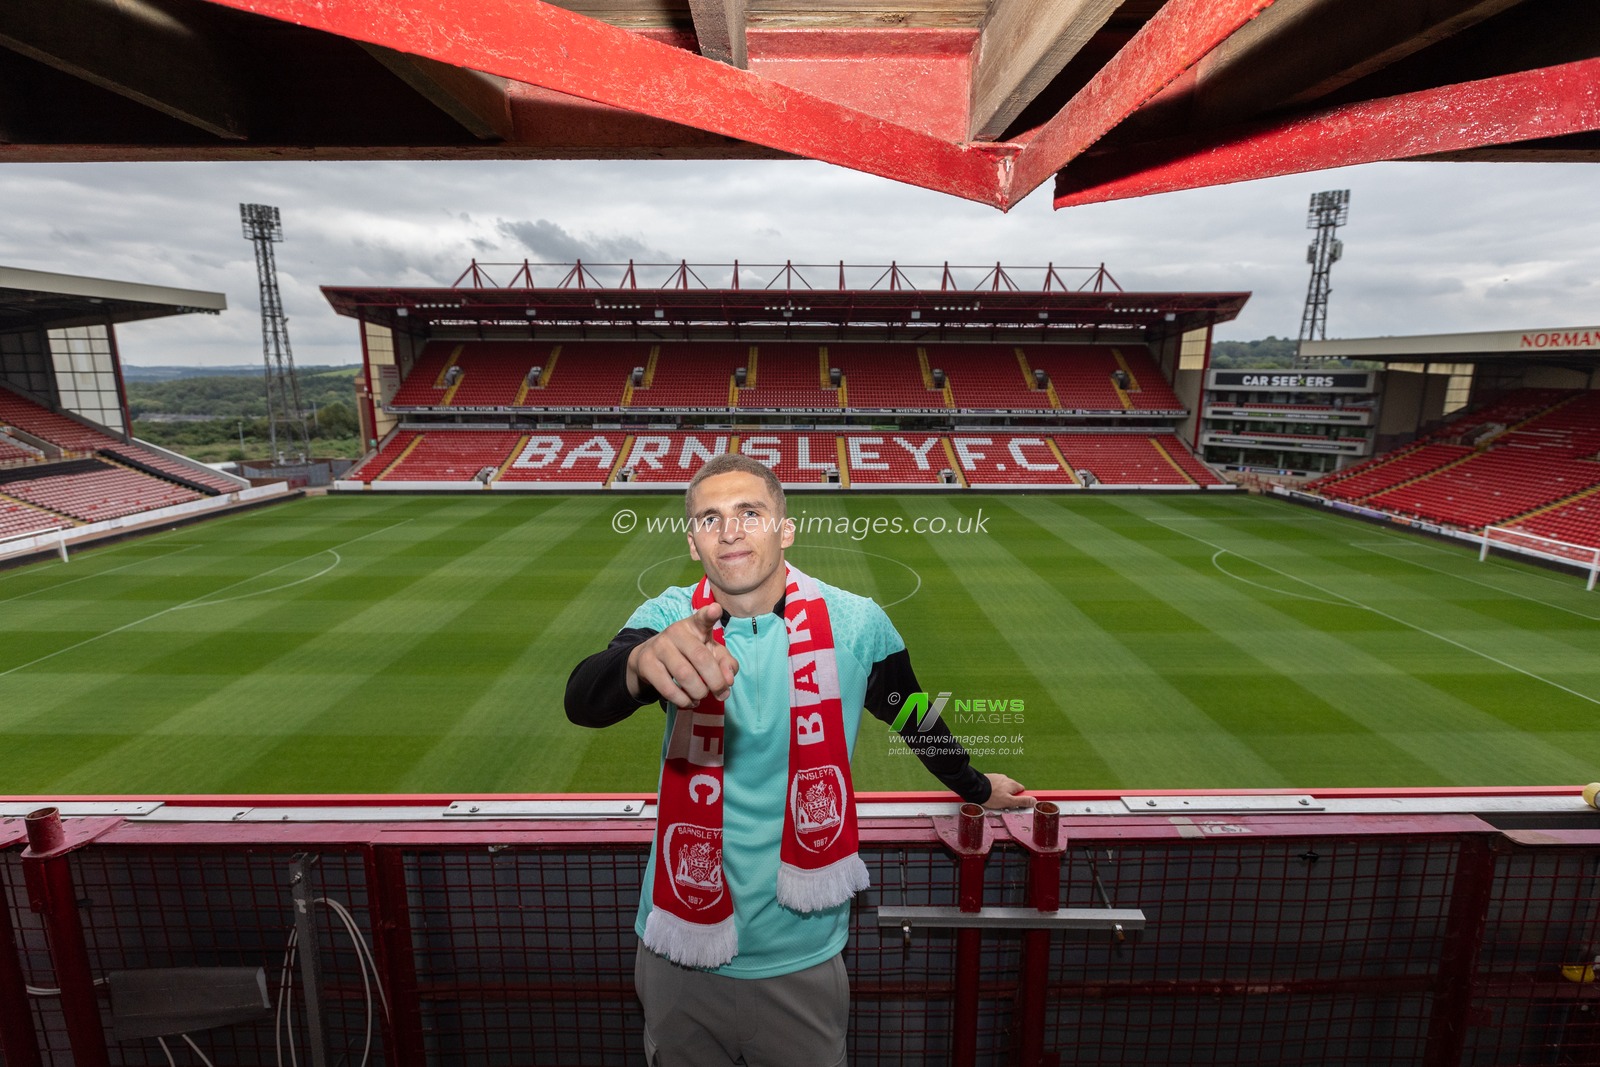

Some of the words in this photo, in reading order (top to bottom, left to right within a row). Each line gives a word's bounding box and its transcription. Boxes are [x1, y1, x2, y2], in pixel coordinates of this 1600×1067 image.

[1242, 375, 1269, 386] CAR
[1271, 374, 1334, 387] SEEKERS
[512, 435, 938, 471] BARNSLEY
